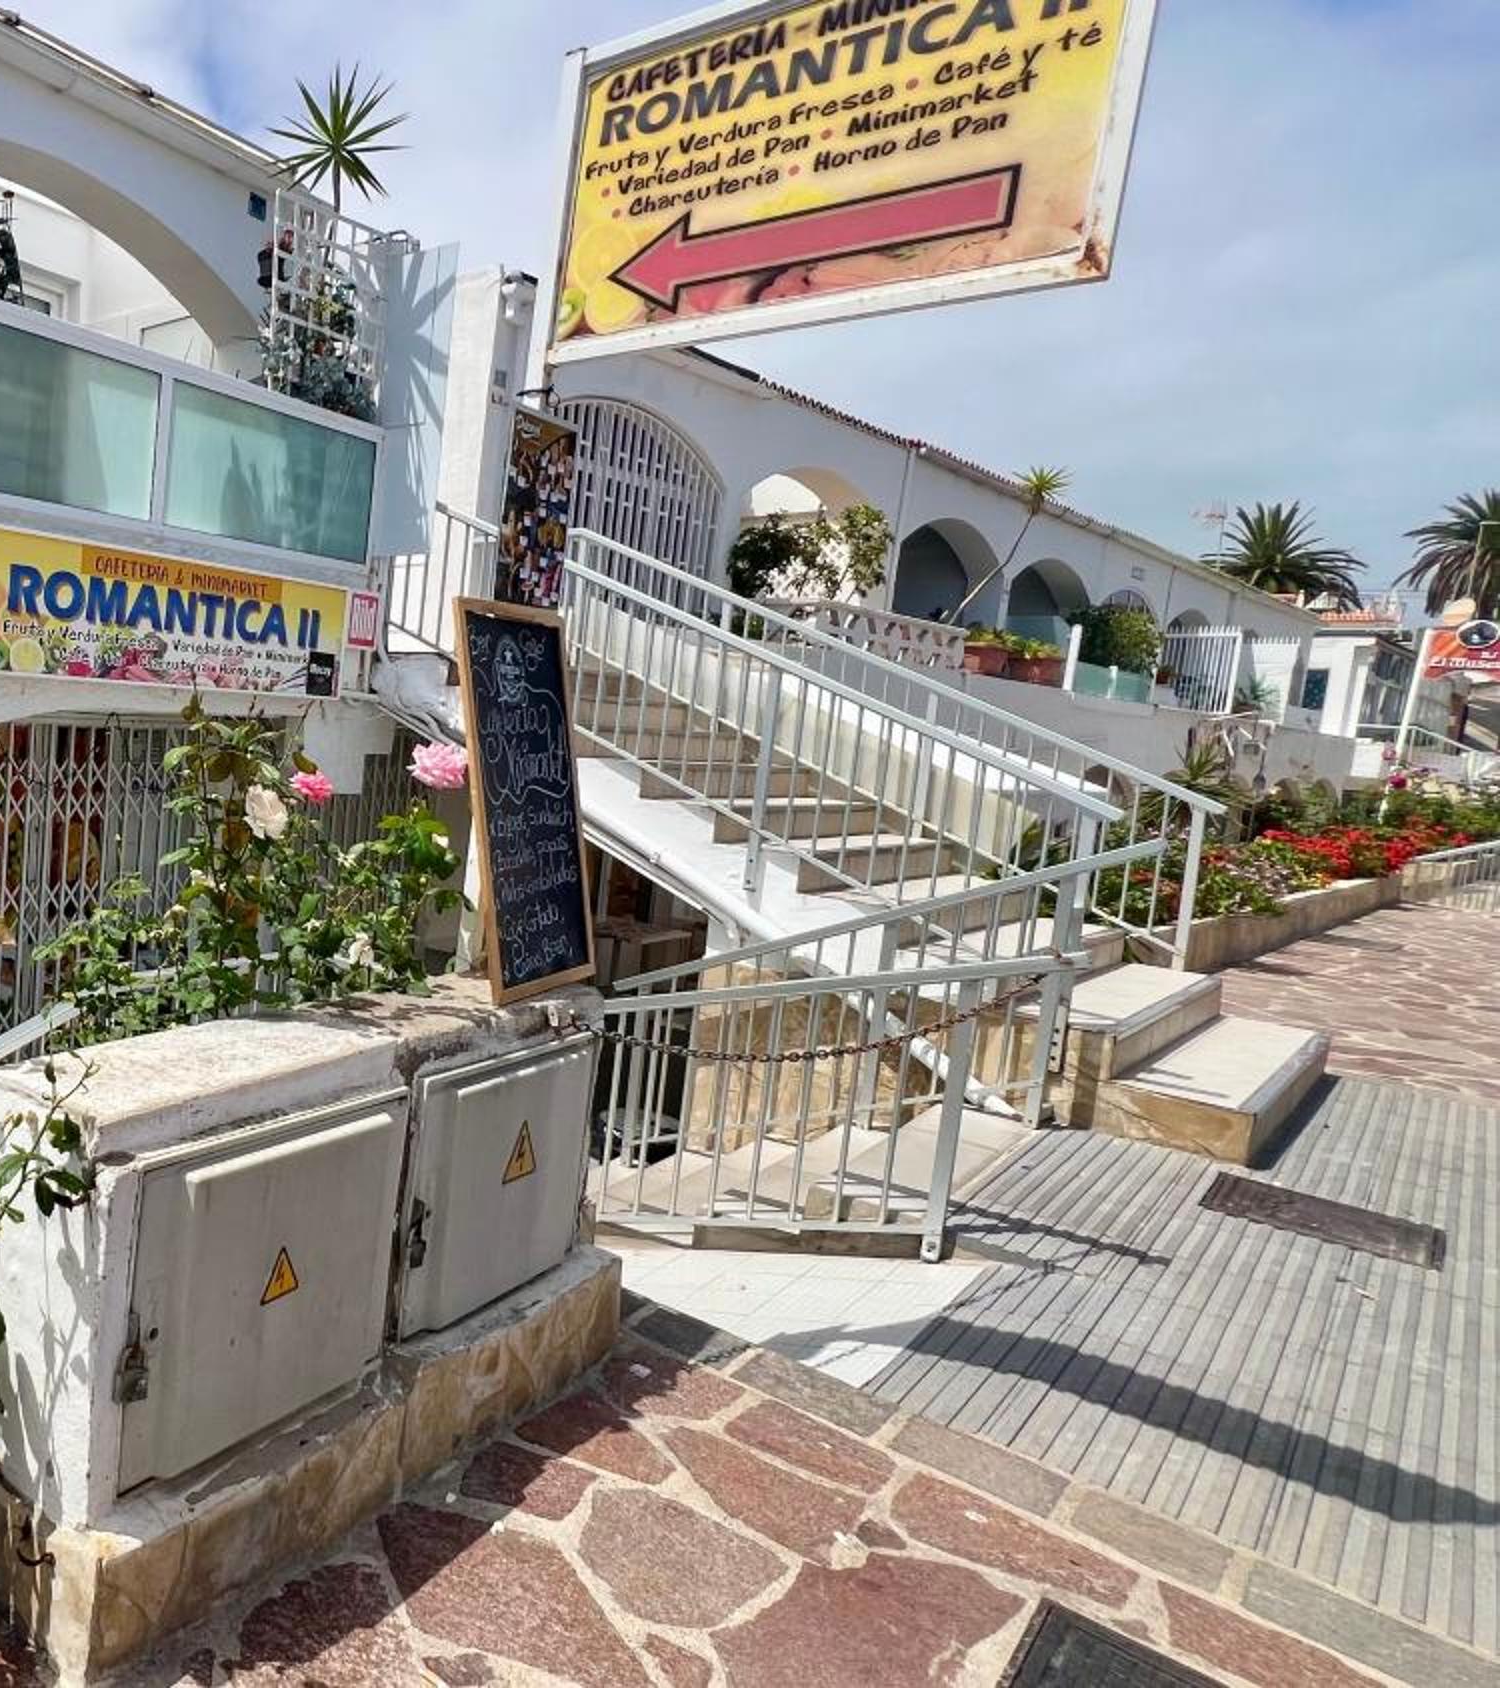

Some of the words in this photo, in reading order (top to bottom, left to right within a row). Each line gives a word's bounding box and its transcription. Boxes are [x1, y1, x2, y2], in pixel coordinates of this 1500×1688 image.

[586, 146, 650, 181] Fruta
[653, 145, 670, 165] y
[678, 115, 782, 157] Verdura
[788, 83, 896, 126] Fresca
[934, 46, 1011, 86] Café
[1021, 43, 1044, 76] y
[1057, 21, 1103, 51] té
[598, 0, 1015, 147] ROMANTICA
[607, 20, 787, 101] CAFETERÍA
[618, 154, 722, 196] Variedad
[726, 143, 755, 169] de
[761, 131, 811, 159] Pan
[847, 69, 1038, 138] Minimarket
[628, 165, 781, 218] Charcutería
[813, 138, 897, 174] Horno
[905, 125, 942, 153] de
[951, 109, 1009, 140] Pan
[7, 563, 288, 647] ROMANTICA
[297, 608, 320, 648] II
[95, 556, 169, 583] CAFETERÍA
